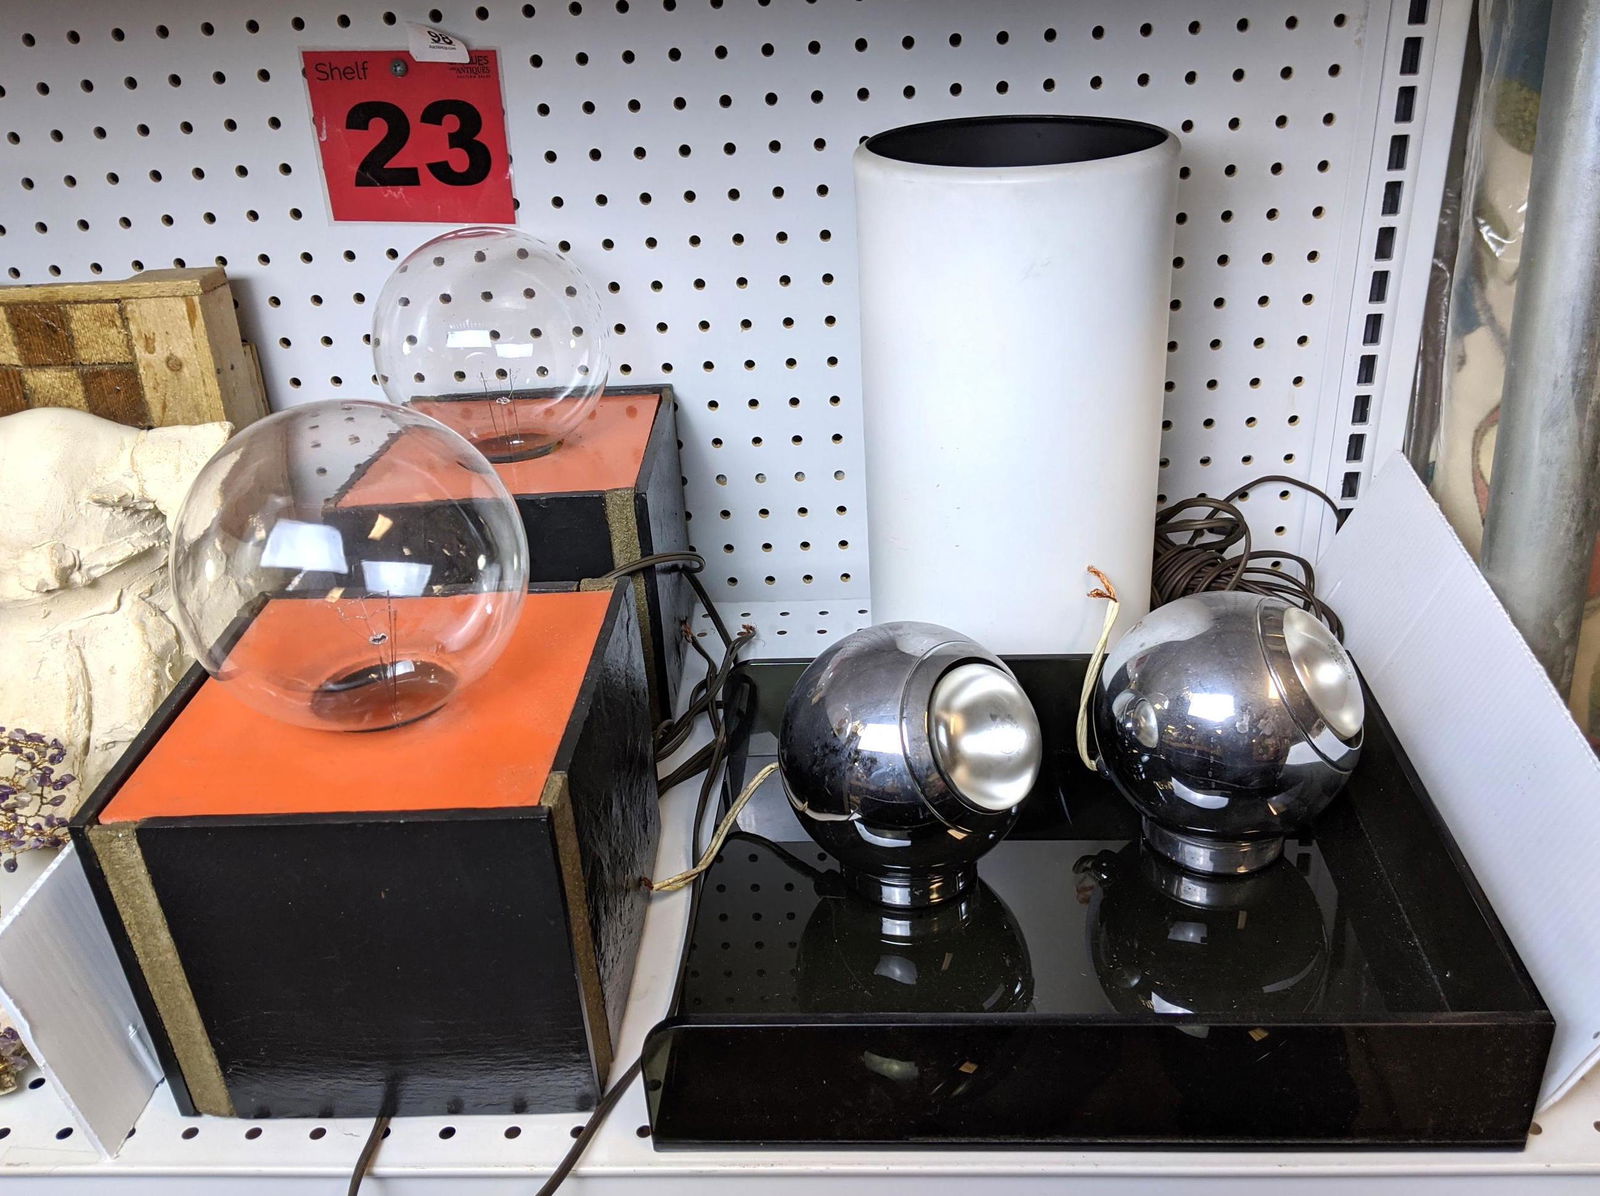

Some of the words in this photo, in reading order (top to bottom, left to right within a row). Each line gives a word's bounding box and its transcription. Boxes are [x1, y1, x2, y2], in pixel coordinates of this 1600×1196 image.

[427, 30, 453, 45] 98
[314, 60, 368, 81] Shelf
[455, 65, 490, 74] ANTIQUES
[345, 98, 492, 187] 23
